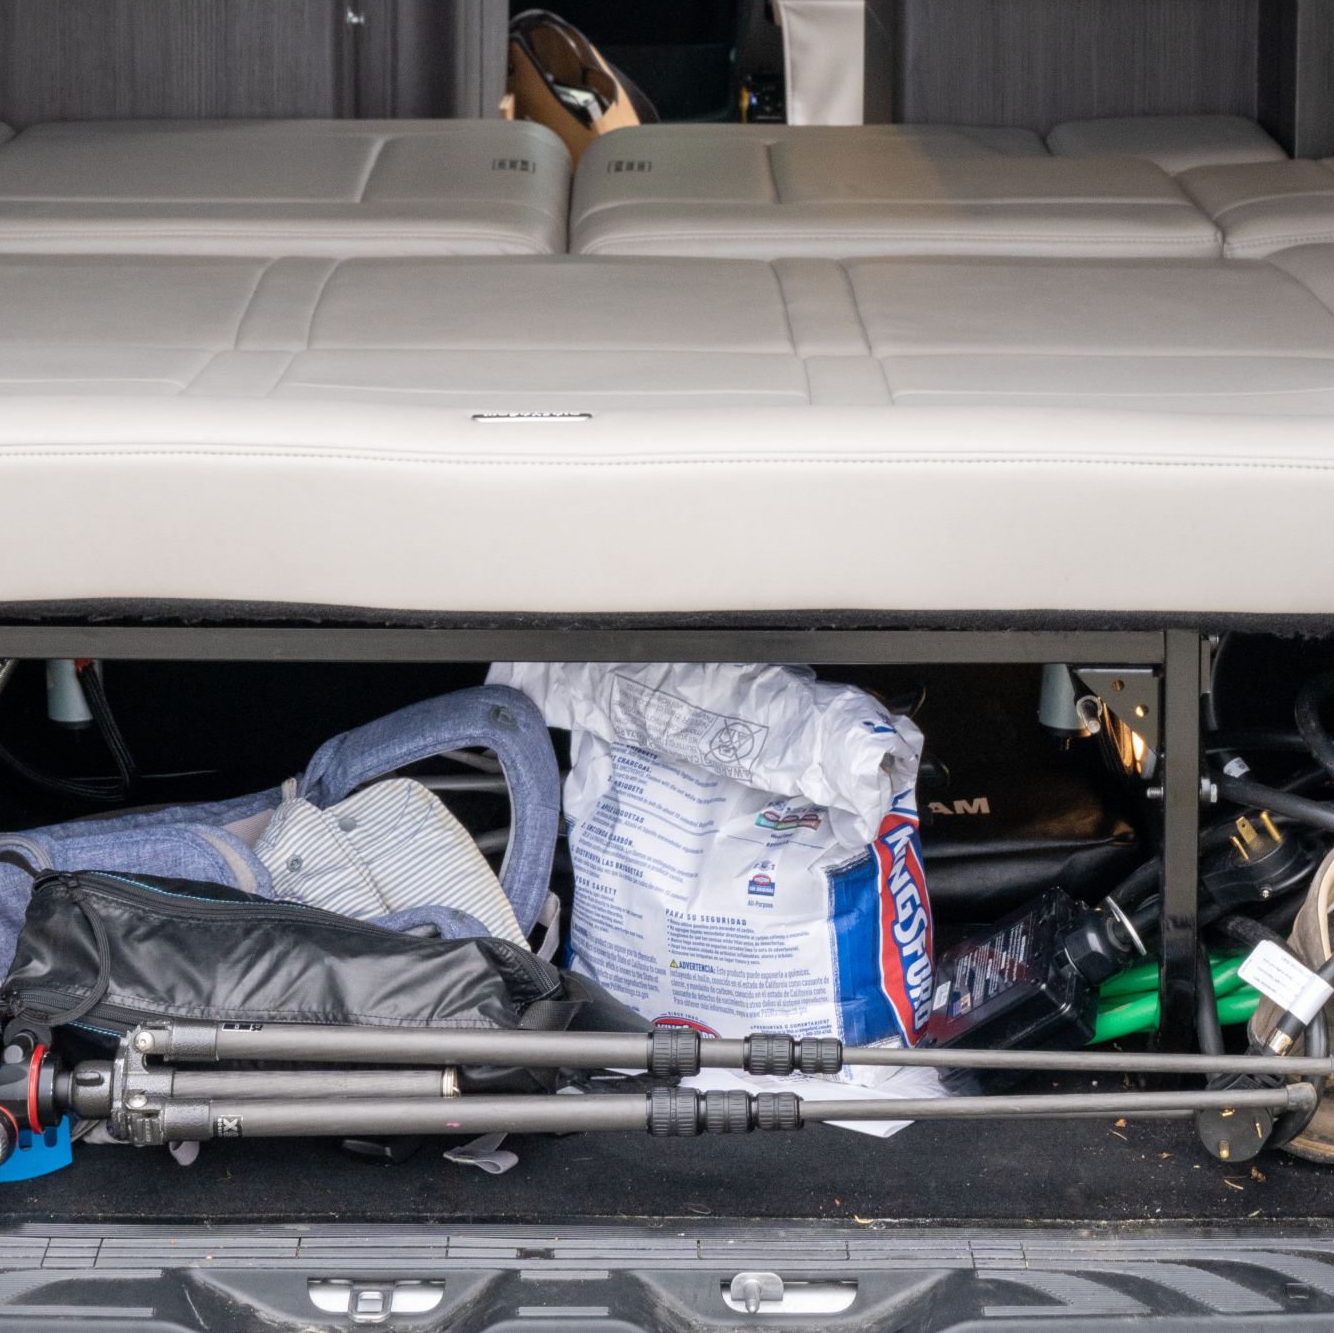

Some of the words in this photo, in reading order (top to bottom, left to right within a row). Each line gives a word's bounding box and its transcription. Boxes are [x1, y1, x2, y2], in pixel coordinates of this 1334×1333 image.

[617, 756, 653, 774] CHARCOAL.
[619, 809, 645, 824] QUETAS
[612, 834, 634, 847] ARBÓN.
[602, 858, 614, 868] LAS
[615, 862, 644, 878] BRIQUETAS
[592, 882, 617, 896] SAFETY
[748, 899, 774, 909] All-Purpose
[665, 908, 685, 920] PARA
[687, 913, 697, 921] SU
[701, 915, 748, 926] SEGURIDAD
[678, 960, 716, 974] ADVERTENCIA:
[764, 979, 788, 989] California
[790, 987, 814, 998] California
